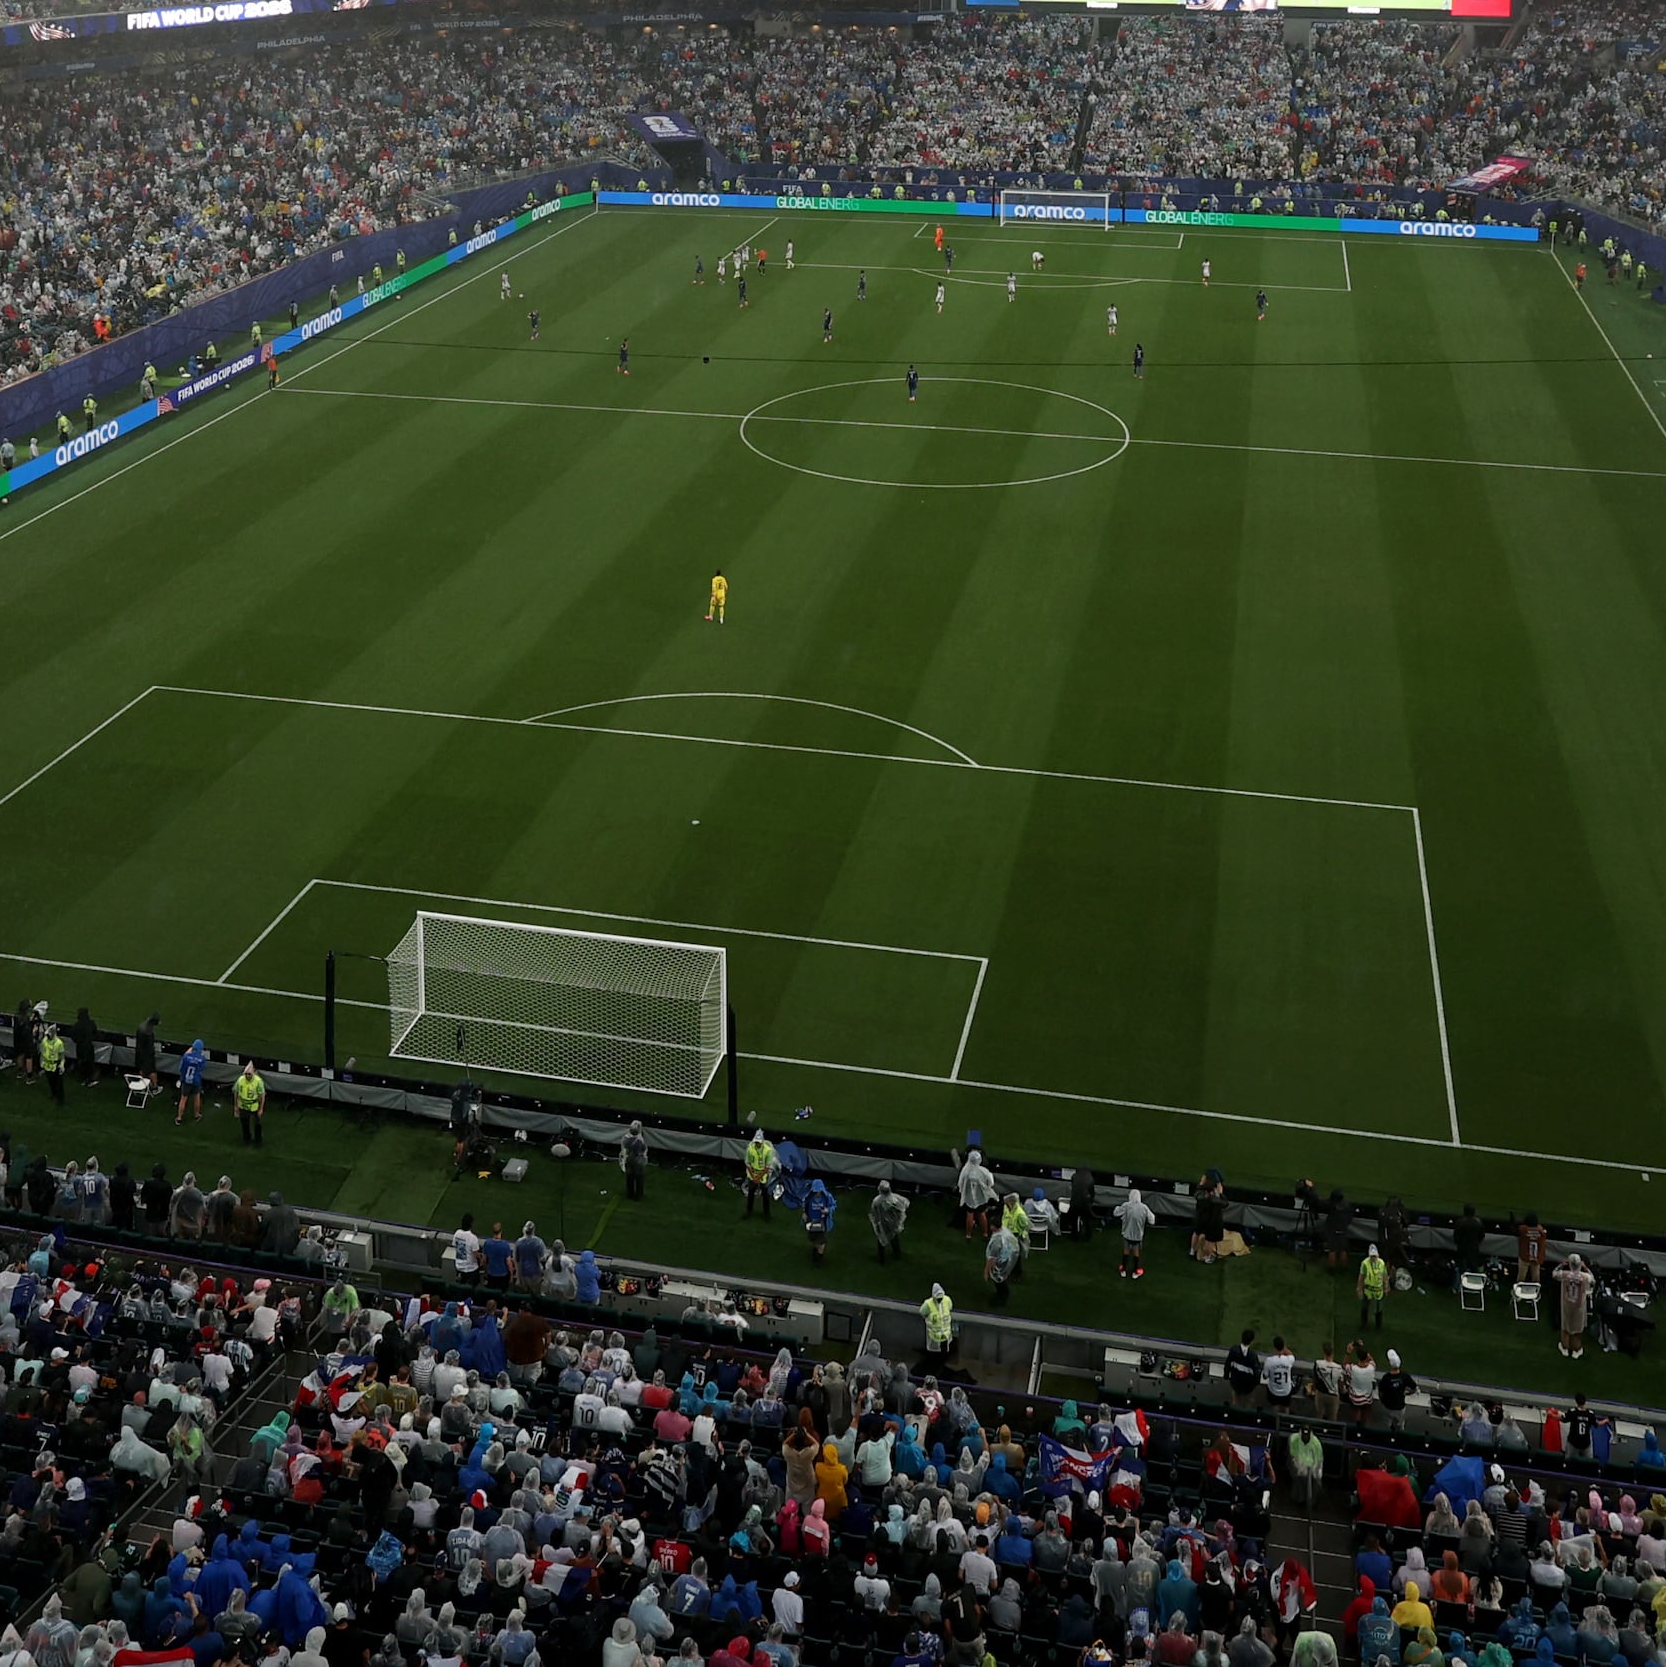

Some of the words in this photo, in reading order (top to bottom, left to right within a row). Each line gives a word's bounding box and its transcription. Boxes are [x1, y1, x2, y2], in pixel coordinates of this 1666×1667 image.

[128, 10, 161, 30] FIFA
[161, 6, 214, 28] WORLD
[215, 3, 242, 22] CUP
[243, 0, 293, 21] 2026
[622, 13, 703, 23] PHILADELPHIA
[257, 35, 326, 50] PHILADELPHIA
[783, 185, 803, 195] FIFA
[652, 193, 721, 206] aramco
[776, 197, 819, 210] GLOBAL
[532, 199, 561, 220] aramco
[1014, 204, 1085, 219] aramco
[1145, 213, 1188, 225] GLOBAL
[1399, 223, 1476, 237] aramco
[466, 230, 496, 253] aramco
[332, 251, 344, 264] FIFA
[363, 286, 385, 309] GLOBAL
[301, 307, 342, 340] aramco
[177, 387, 193, 402] FIFA
[193, 374, 218, 393] WORLD
[217, 368, 231, 383] CUP
[231, 355, 255, 375] 2026
[55, 420, 119, 466] aramco
[84, 1179, 95, 1194] 10
[1273, 1371, 1288, 1385] 21
[394, 1398, 405, 1412] 10
[926, 1395, 937, 1415] 9
[579, 1405, 593, 1424] 10
[1579, 1423, 1586, 1435] 6
[38, 1438, 46, 1451] 7
[533, 1431, 546, 1449] 10
[453, 1547, 471, 1566] 10
[661, 1556, 674, 1572] 10
[684, 1594, 694, 1613] 7
